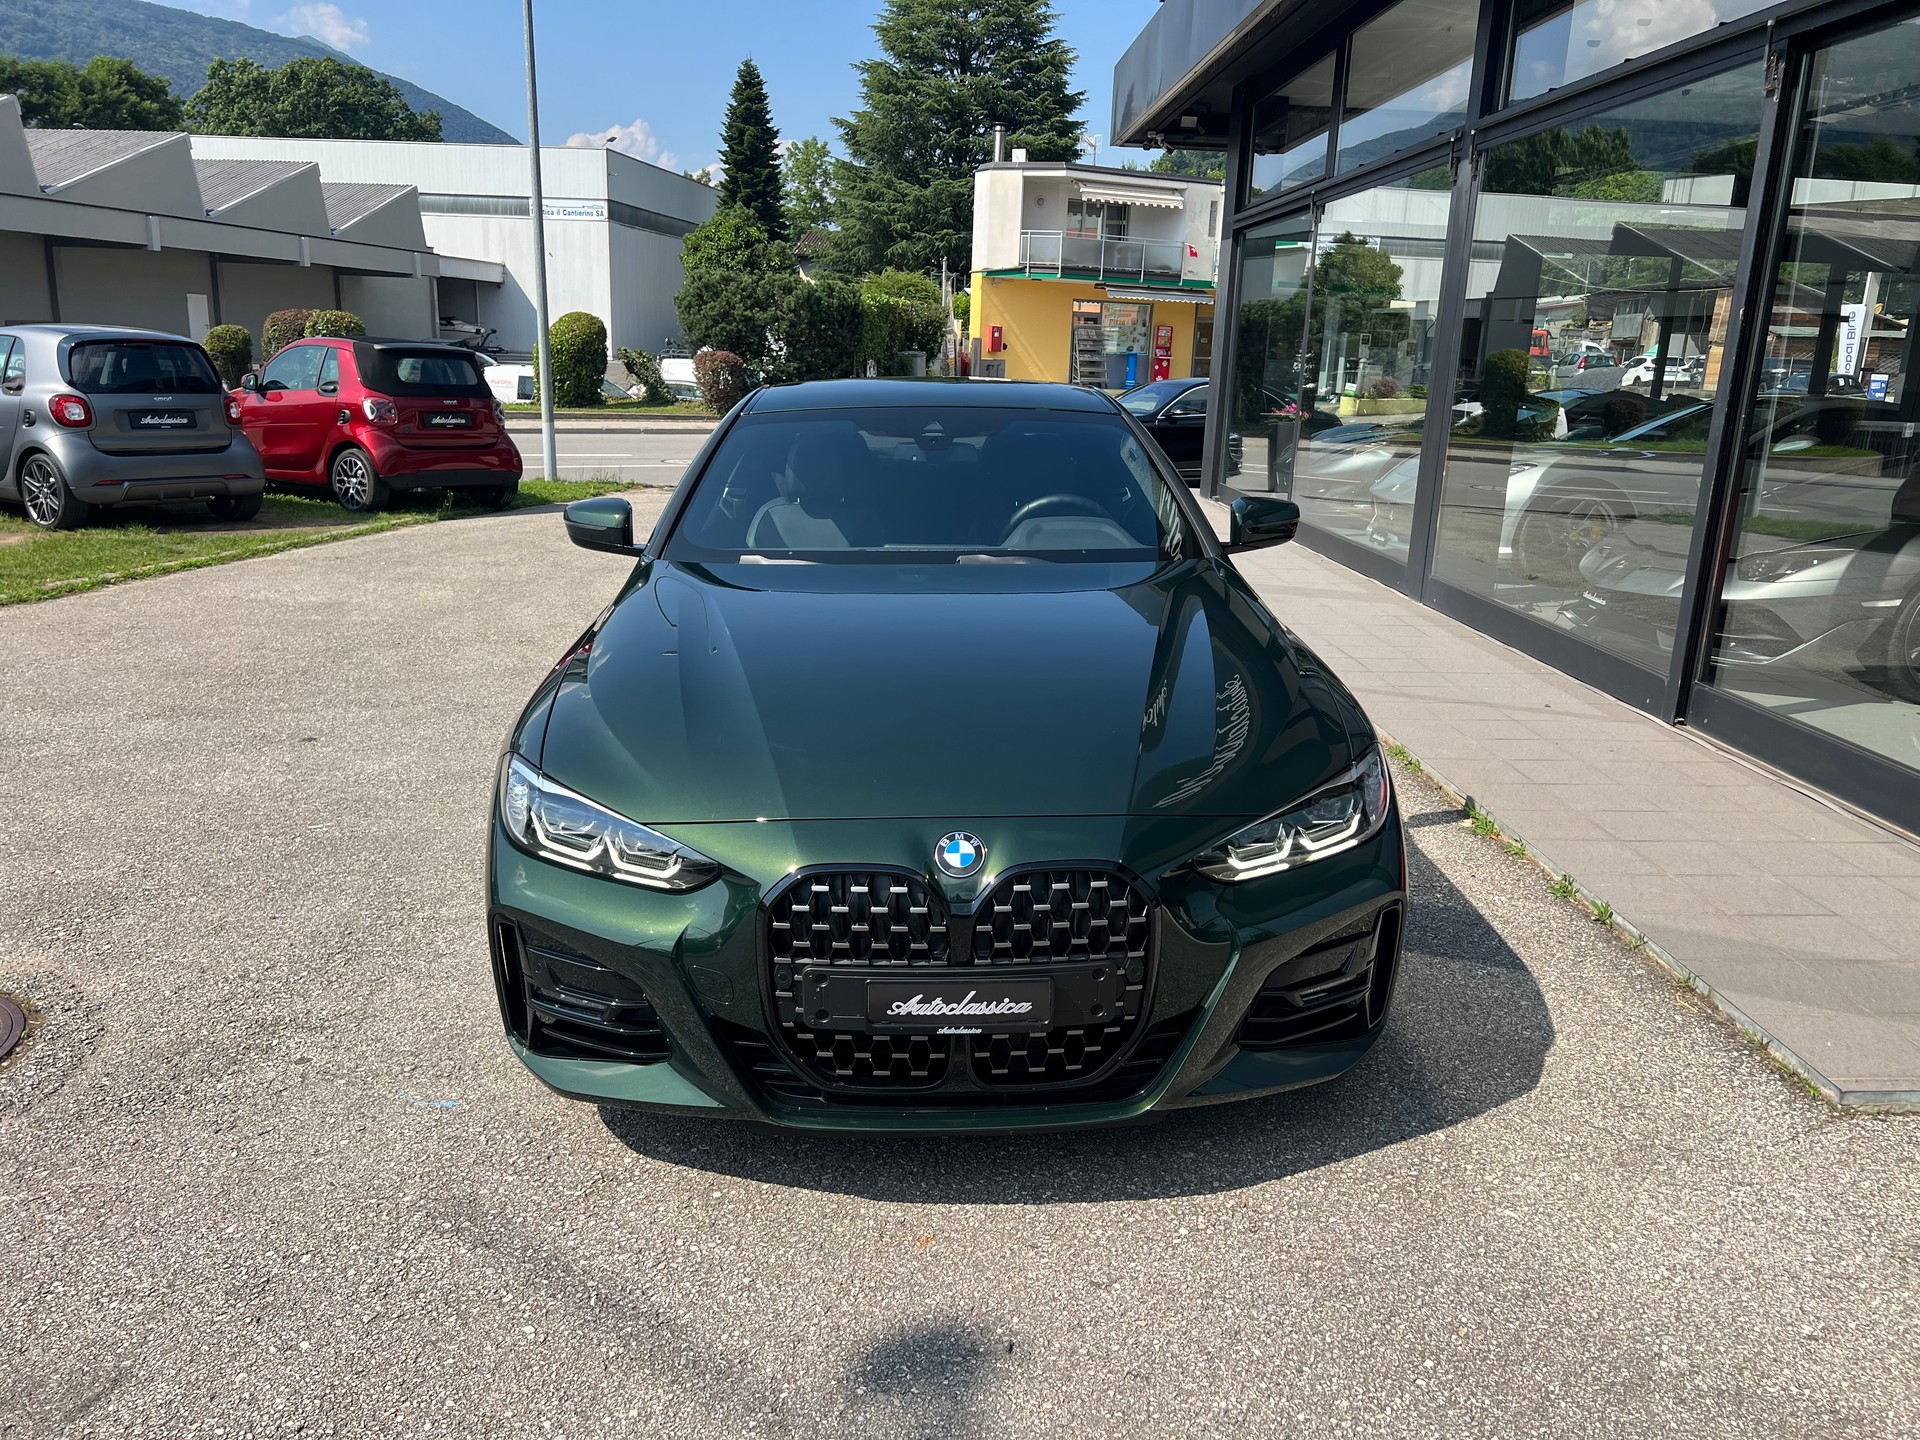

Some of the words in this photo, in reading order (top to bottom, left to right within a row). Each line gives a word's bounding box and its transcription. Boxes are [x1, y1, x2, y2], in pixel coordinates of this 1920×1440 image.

[562, 208, 594, 217] Cantierino
[595, 209, 605, 217] SA
[140, 413, 189, 425] Autoclassica
[939, 833, 980, 848] BMW
[886, 990, 1034, 1016] Autoclassica
